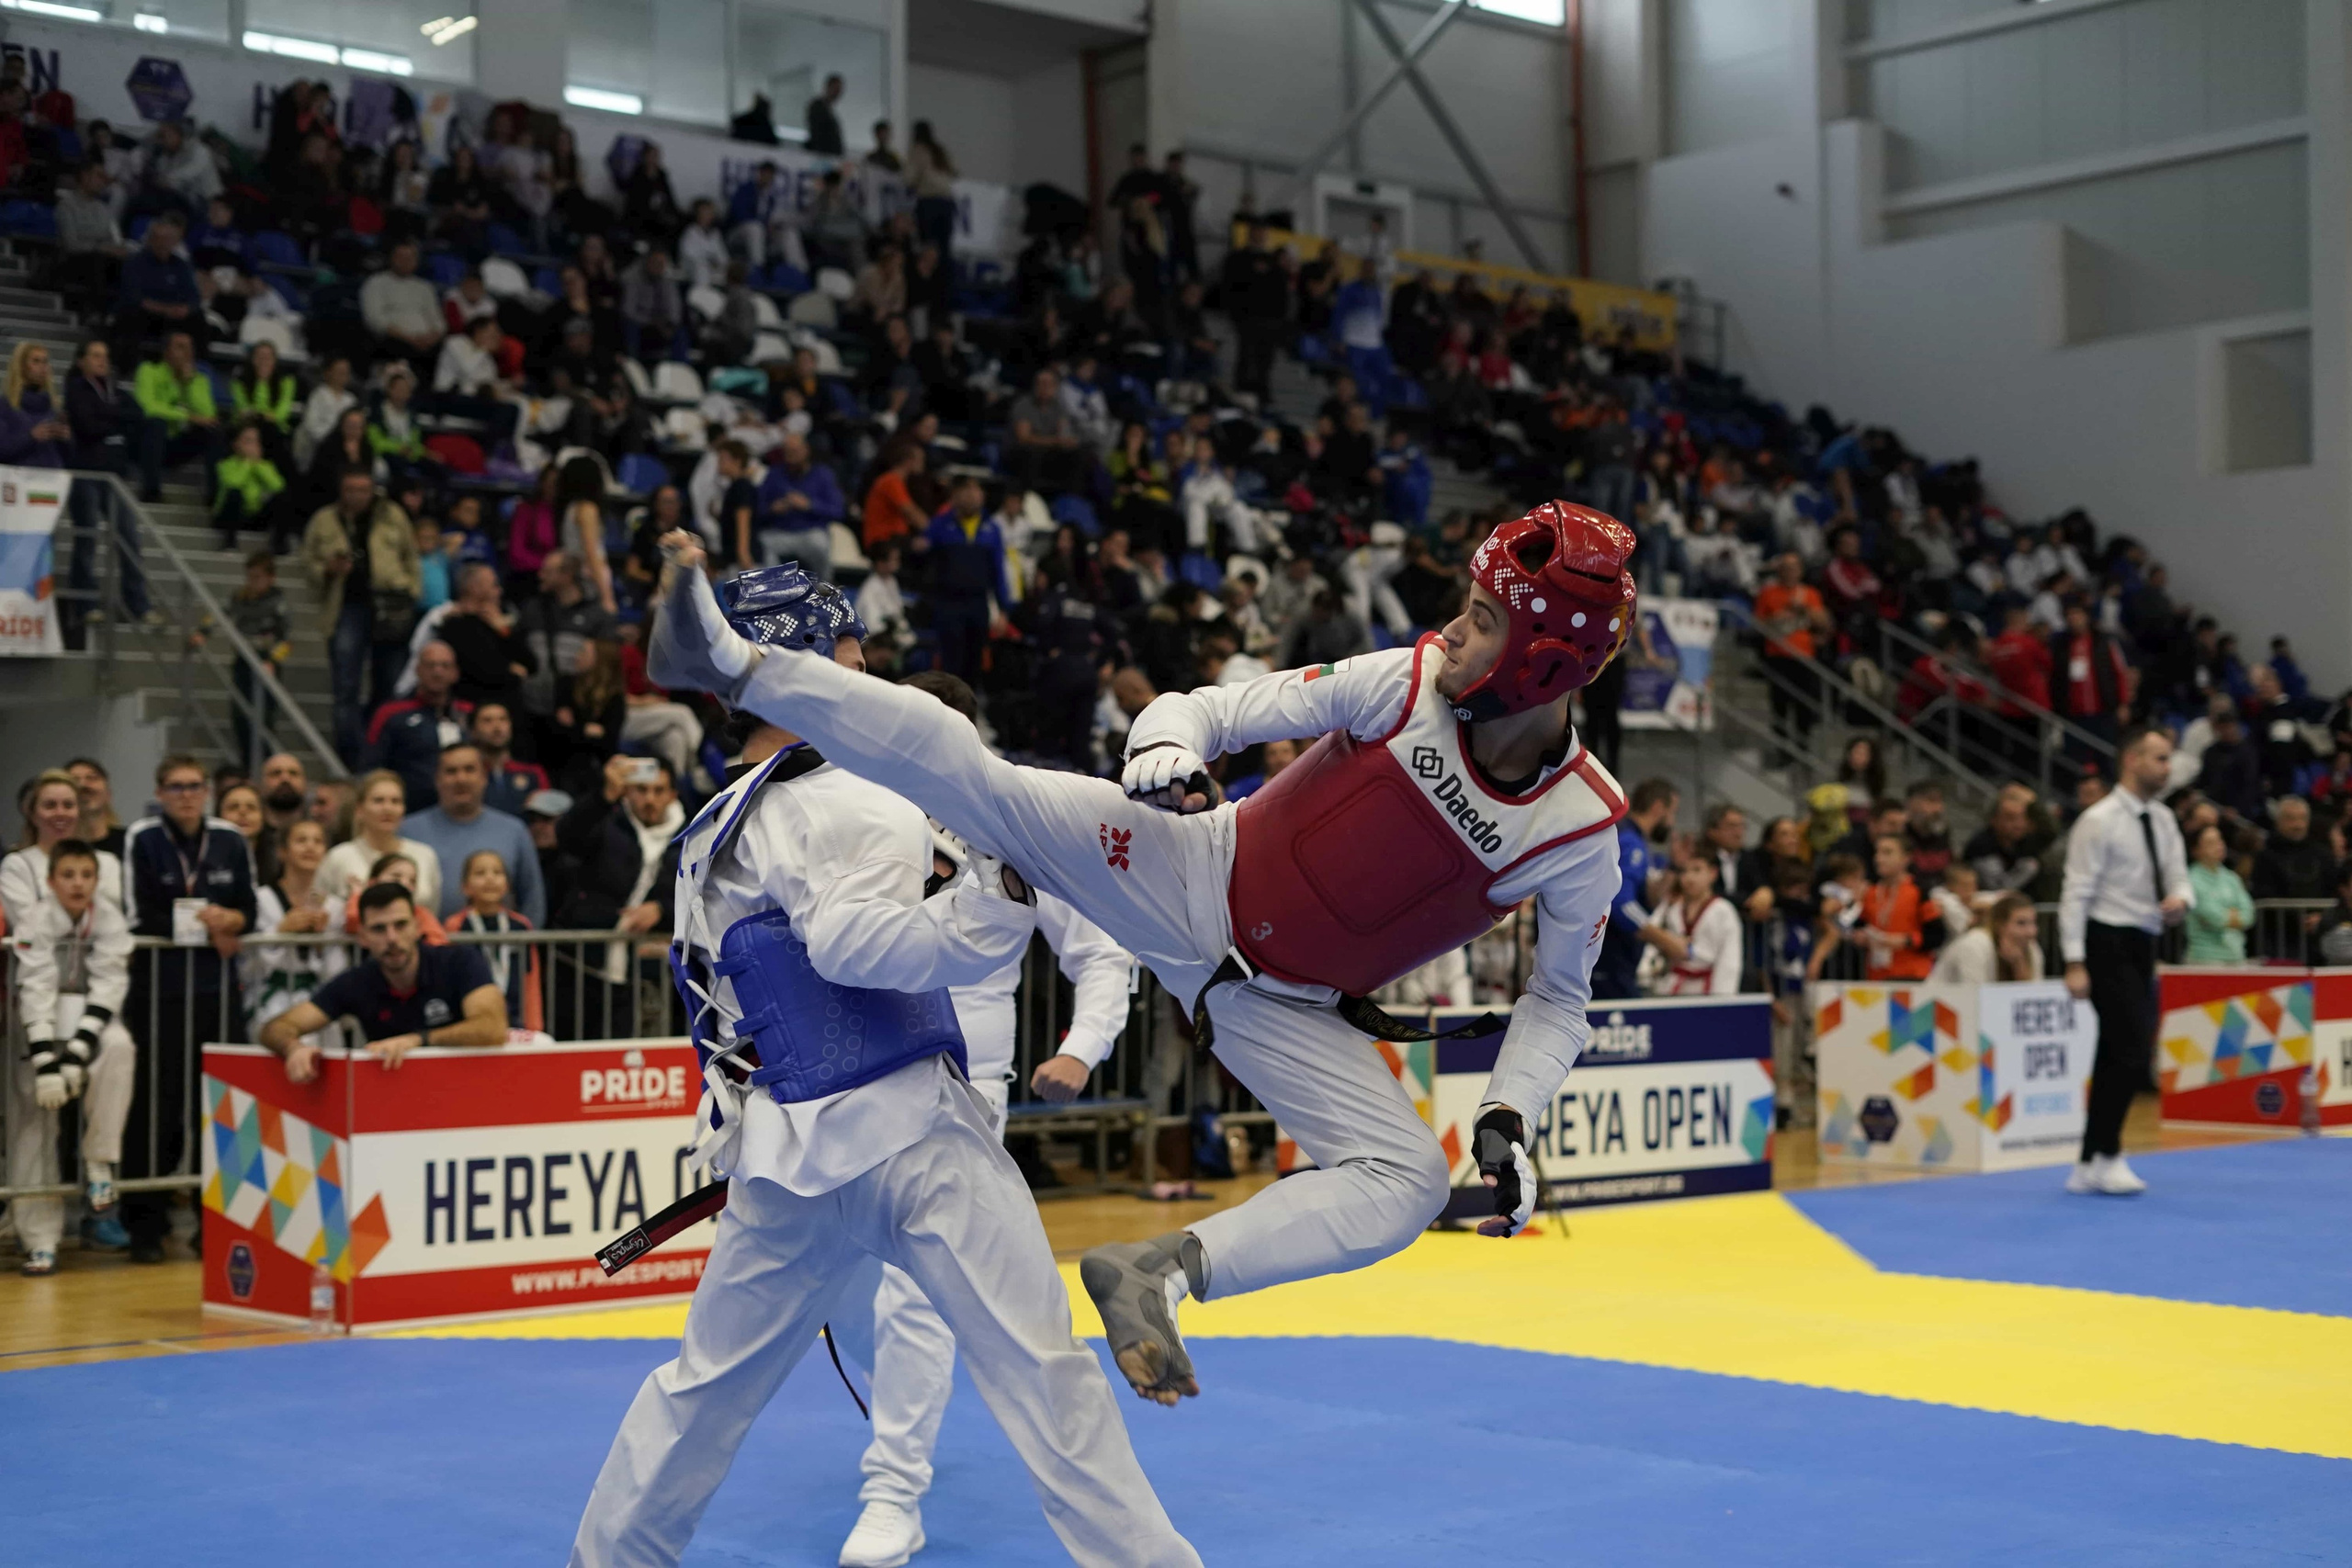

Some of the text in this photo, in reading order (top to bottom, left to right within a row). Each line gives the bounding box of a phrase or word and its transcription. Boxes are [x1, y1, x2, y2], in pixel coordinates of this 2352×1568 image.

[1433, 773, 1502, 853] Daedo
[1251, 922, 1272, 941] 3
[581, 1066, 686, 1103] PRIDE
[1535, 1084, 1731, 1157] REYA OPEN
[424, 1148, 648, 1246] HEREYA
